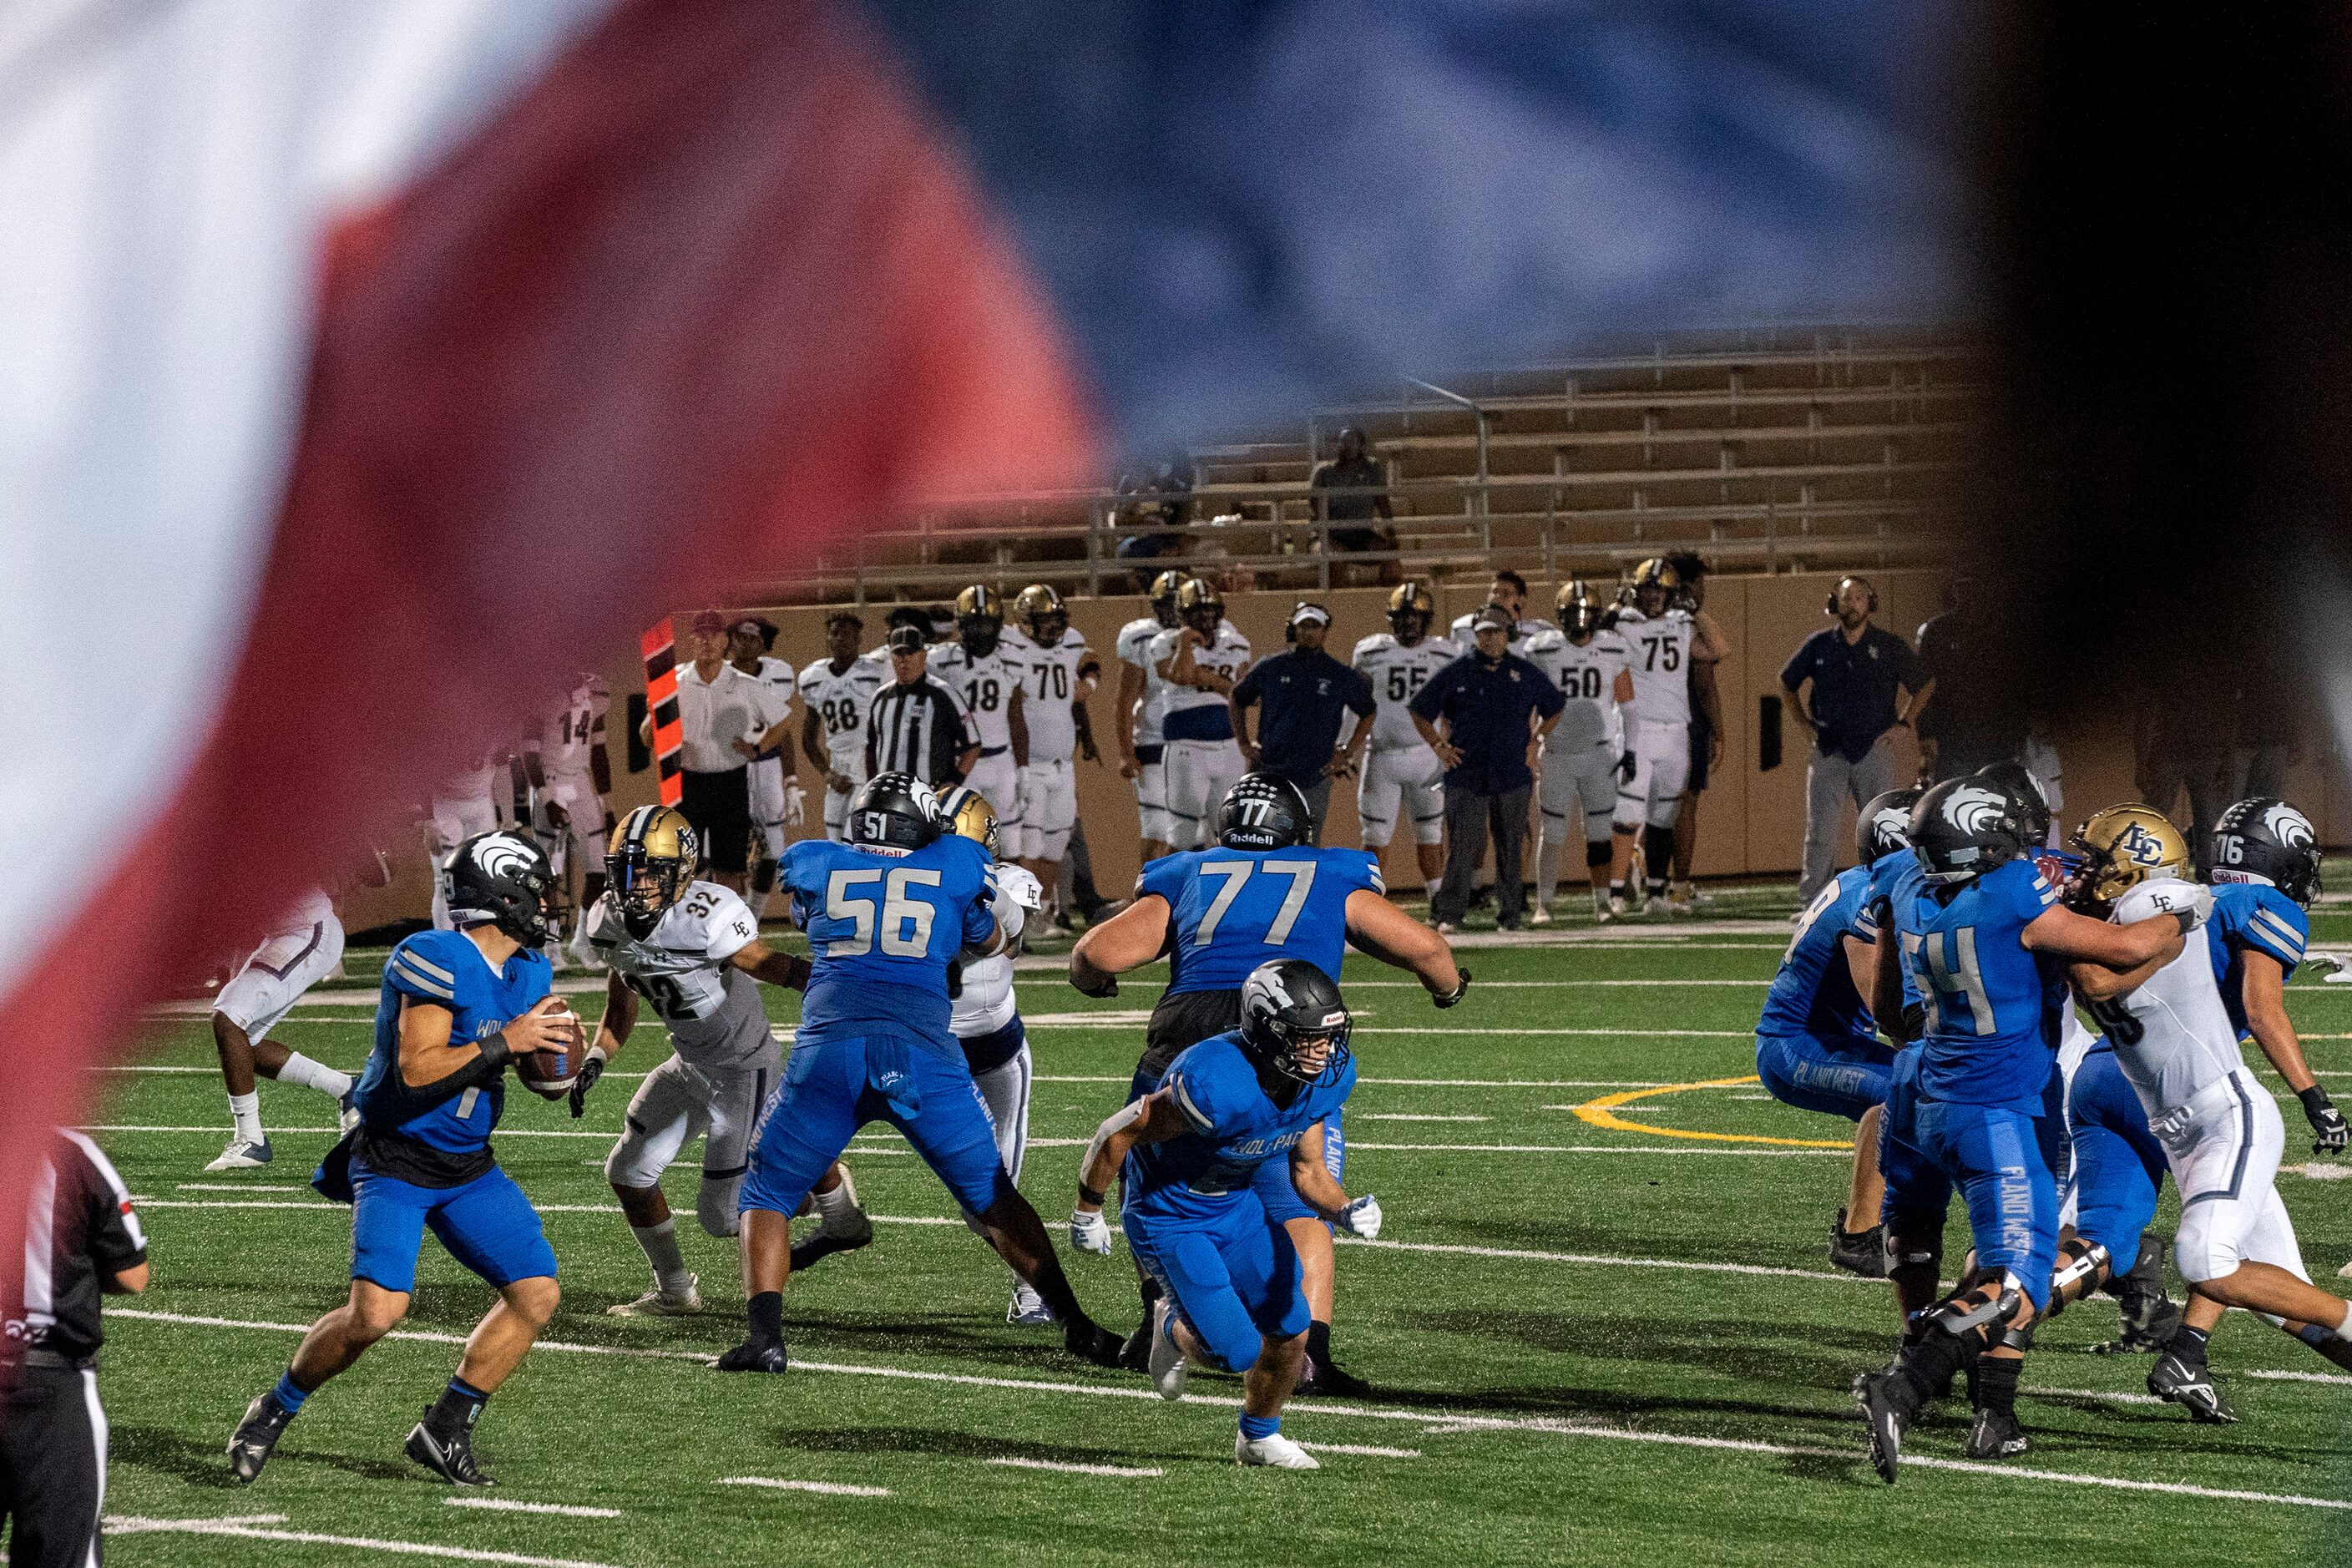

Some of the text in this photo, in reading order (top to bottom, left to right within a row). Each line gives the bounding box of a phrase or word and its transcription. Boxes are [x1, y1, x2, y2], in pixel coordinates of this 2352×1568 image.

[1641, 636, 1680, 672] 75
[964, 678, 999, 711] 18
[1033, 663, 1067, 701] 70
[1388, 666, 1428, 701] 55
[1561, 666, 1601, 699] 50
[559, 710, 590, 746] 14
[864, 811, 888, 841] 51
[1239, 798, 1271, 827] 77
[860, 846, 903, 857] Riddell
[1230, 833, 1274, 845] Riddell
[2122, 823, 2163, 867] LE
[2217, 833, 2244, 865] 76
[2213, 871, 2249, 884] Riddell
[686, 891, 721, 918] 32
[1027, 884, 1038, 906] LE
[1194, 859, 1319, 947] 77
[2150, 893, 2174, 913] LE
[731, 920, 750, 938] LE
[826, 867, 942, 959] 56
[1326, 1126, 1343, 1179] PLANO
